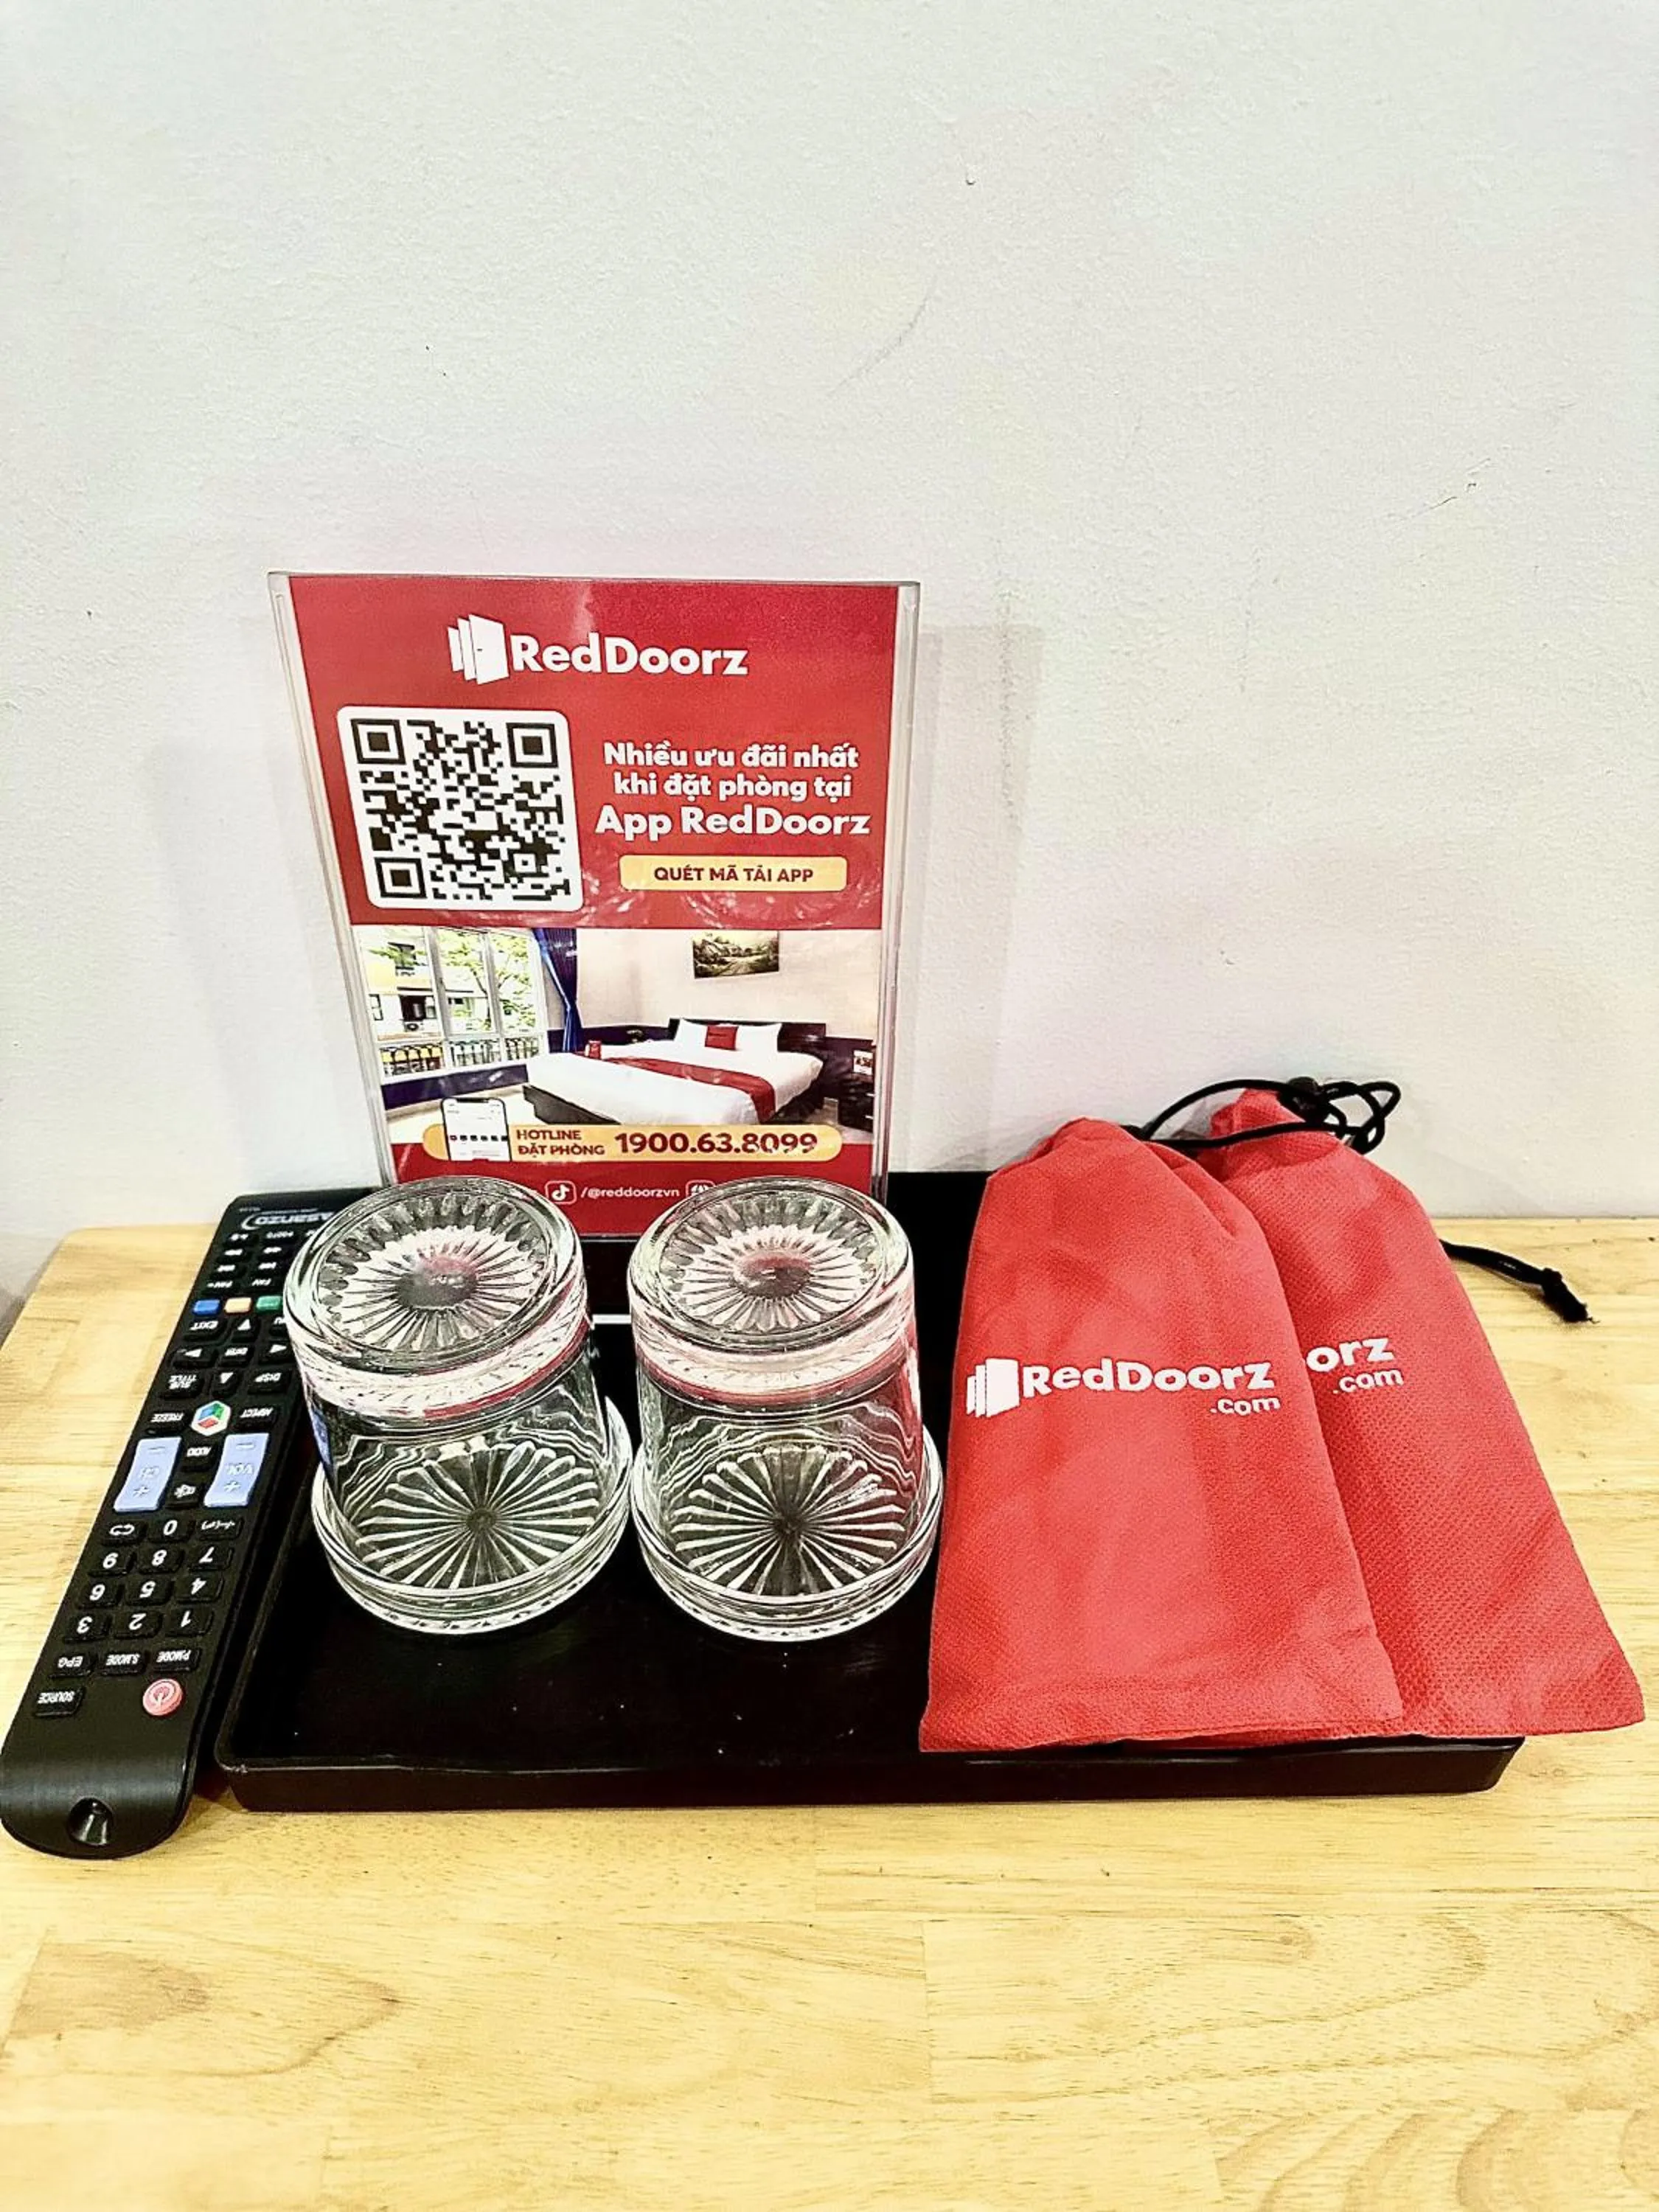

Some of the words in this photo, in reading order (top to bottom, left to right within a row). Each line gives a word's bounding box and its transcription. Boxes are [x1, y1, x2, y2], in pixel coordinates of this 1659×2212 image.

[510, 632, 749, 676] RedDoorz
[604, 740, 688, 768] Nhiều
[694, 748, 735, 768] ưu
[741, 743, 787, 768] đãi
[793, 742, 859, 768] nhất
[613, 771, 657, 796] khi
[663, 772, 712, 801] đặt
[720, 772, 807, 802] phòng
[814, 774, 852, 803] tại
[594, 804, 672, 841] App
[681, 804, 872, 835] RedDoorz
[654, 864, 704, 881] QUÉT
[709, 864, 738, 881] MÃ
[777, 868, 814, 883] APP
[516, 1130, 582, 1141] HOTLINE
[614, 1133, 818, 1155] 1900.63.8099
[518, 1144, 546, 1158] ĐẶT
[549, 1144, 605, 1156] PHÒNG
[189, 1321, 219, 1331] EXIT
[254, 1372, 282, 1382] DISP
[1023, 1357, 1276, 1399] RedDoorz
[1332, 1368, 1405, 1394] .com
[1209, 1395, 1281, 1417] .com
[163, 1519, 178, 1537] 0
[102, 1551, 119, 1569] 9
[151, 1549, 167, 1566] 8
[199, 1546, 215, 1564] 7
[89, 1584, 105, 1601] 6
[139, 1580, 156, 1599] 5
[190, 1577, 207, 1595] 4
[76, 1615, 93, 1635] 3
[128, 1613, 147, 1631] 2
[180, 1610, 192, 1628] 1
[57, 1655, 83, 1669] EPG
[38, 1690, 75, 1705] SOURCE
